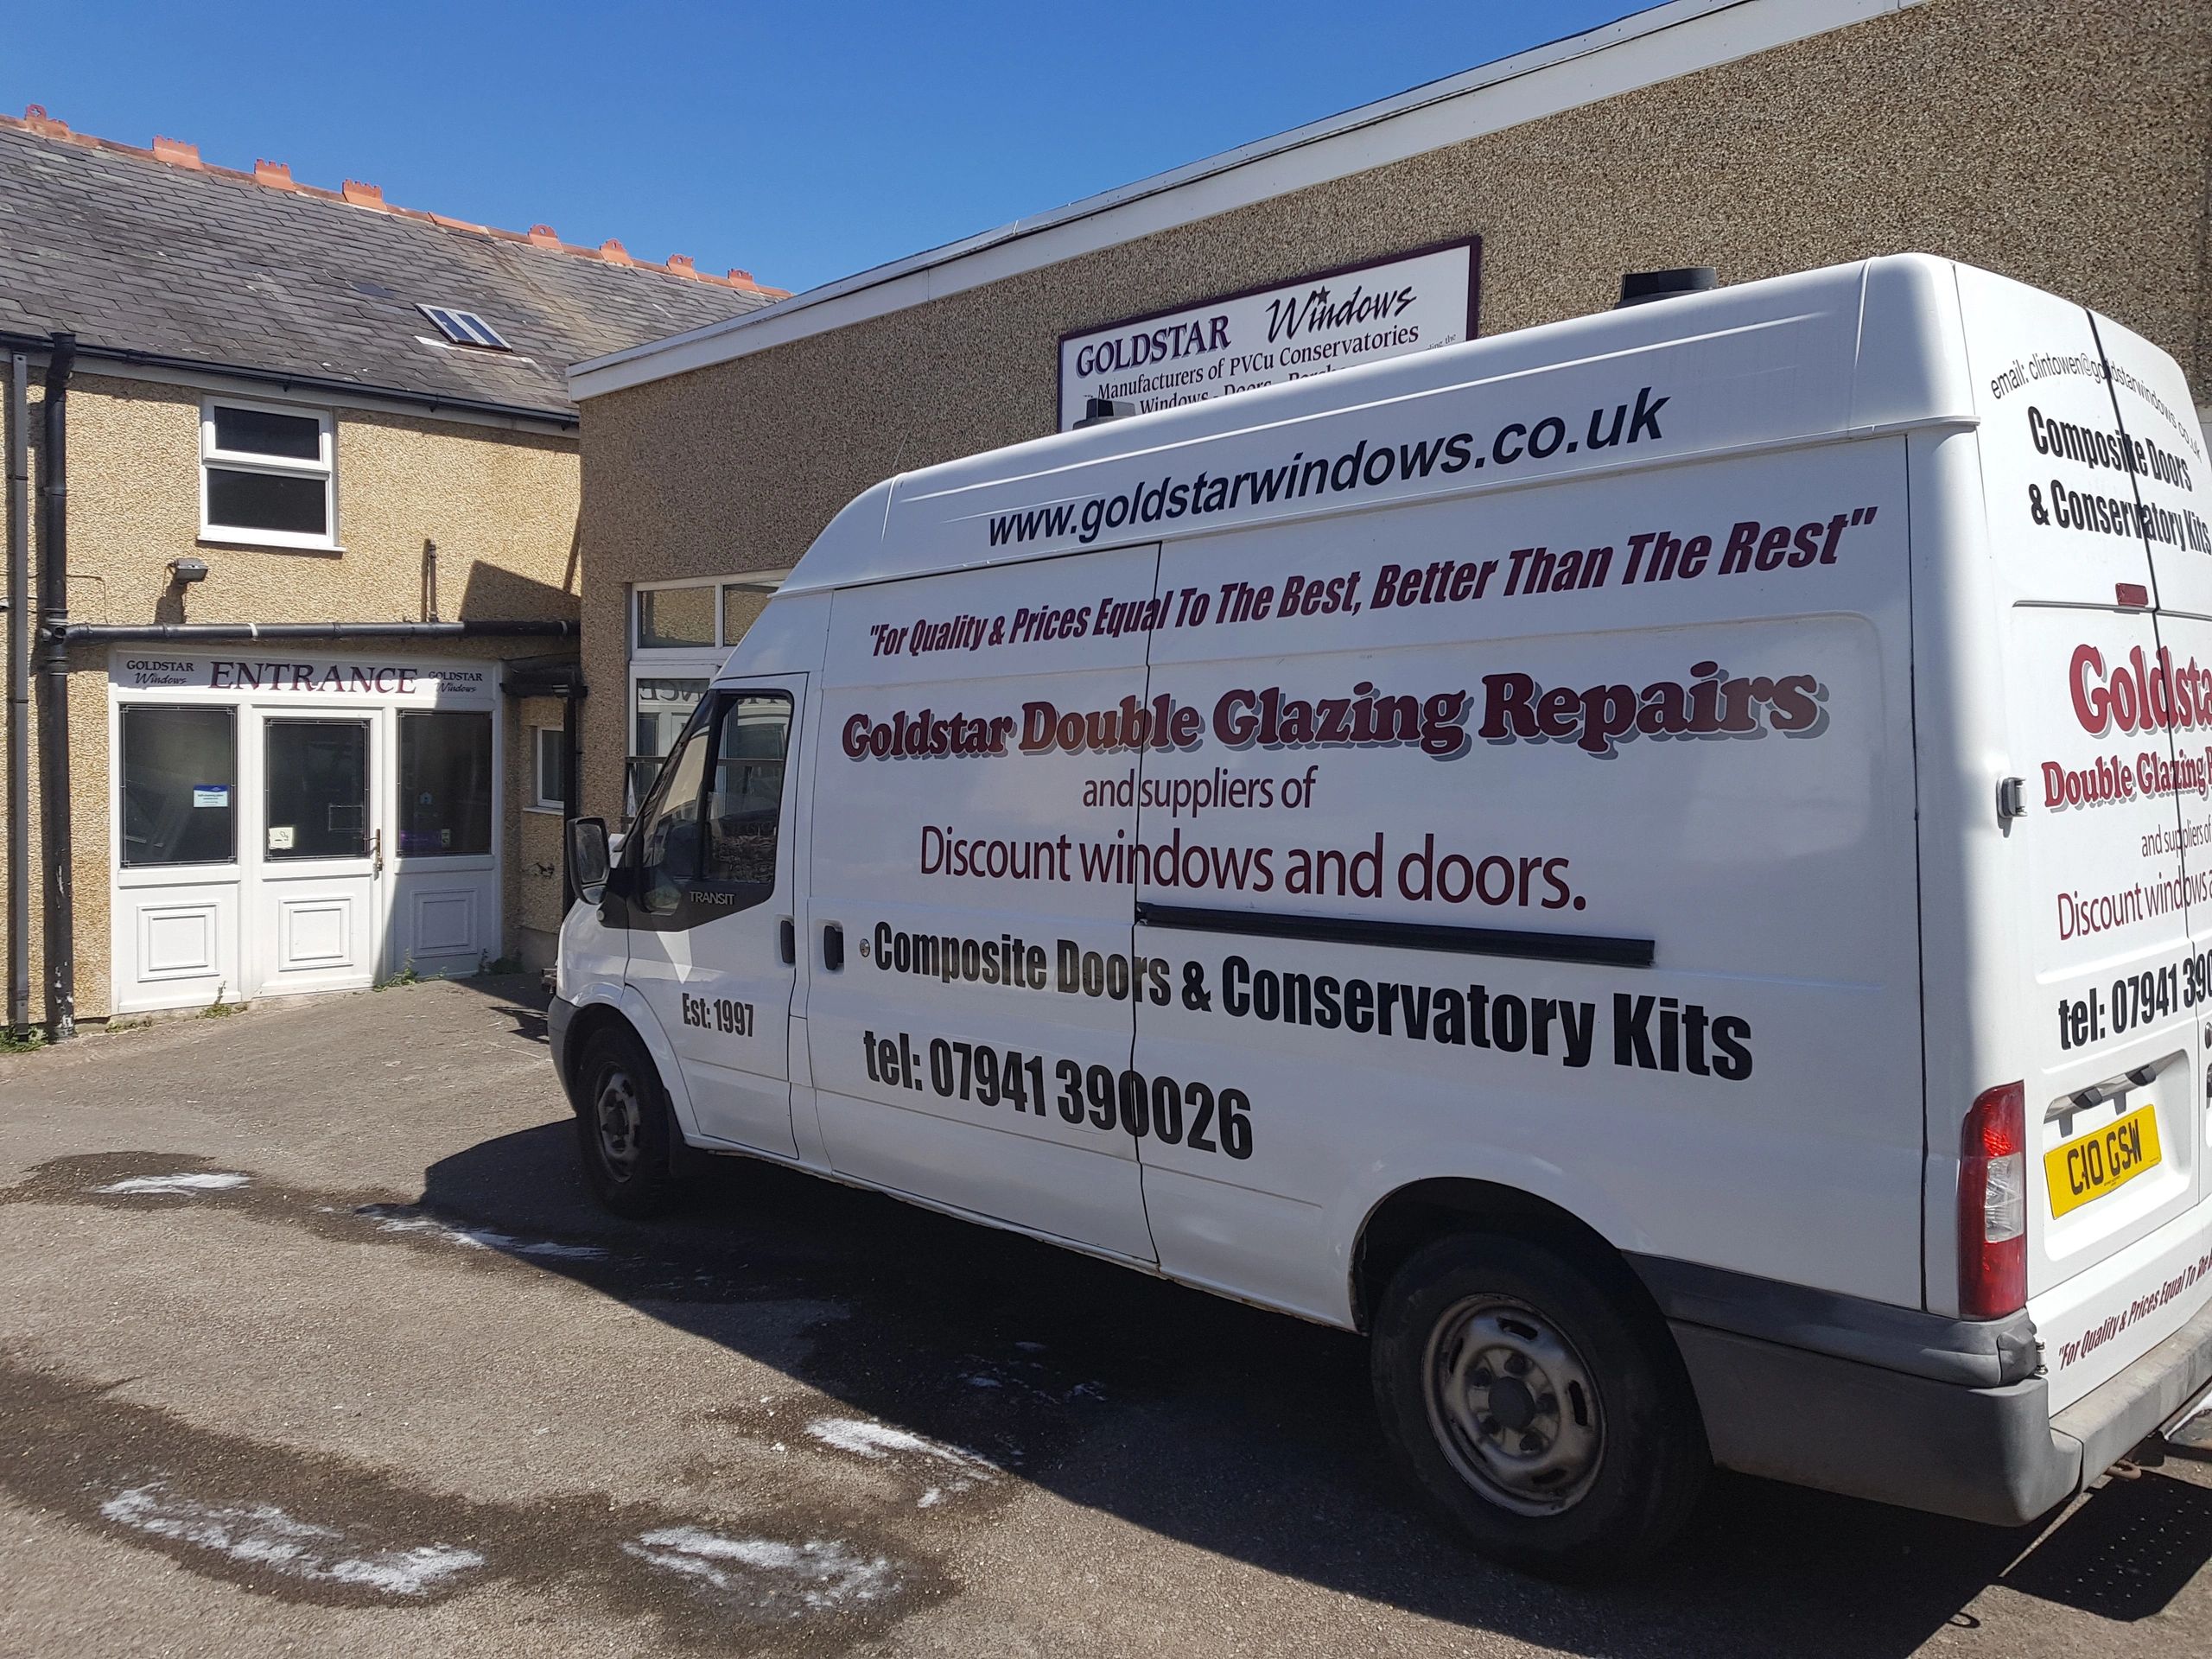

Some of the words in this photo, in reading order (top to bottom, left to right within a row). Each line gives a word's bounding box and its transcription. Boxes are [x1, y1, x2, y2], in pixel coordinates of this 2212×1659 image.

[1076, 315, 1232, 378] GOLDSTAR
[1265, 285, 1418, 344] Windows
[1098, 368, 1204, 399] Manufacturers
[1208, 358, 1226, 380] of
[1230, 353, 1274, 377] PVCu
[1280, 326, 1419, 366] Conservatories
[1140, 391, 1209, 415] Windows
[1990, 359, 2030, 400] email:
[988, 386, 1671, 547] www.goldstarwindows.co.uk
[2027, 405, 2149, 477] Composite
[2145, 437, 2193, 493] Doors
[2028, 483, 2050, 526] &
[2050, 479, 2186, 552] Conservatory
[2183, 508, 2212, 556] Kits
[869, 624, 906, 657] "For
[909, 613, 987, 657] Quality
[988, 615, 1006, 645] &
[1008, 604, 1090, 645] Prices
[1092, 590, 1173, 640] Equal
[1175, 588, 1210, 628] To
[1215, 581, 1274, 623] The
[1276, 569, 1363, 619] Best,
[1370, 558, 1498, 609] Better
[1503, 546, 1614, 597] Than
[1621, 531, 1713, 585] The
[1717, 506, 1878, 575] Rest"
[126, 660, 194, 672] GOLDSTAR
[134, 672, 187, 685] Windows
[208, 660, 418, 694] ENTRANCE
[428, 671, 483, 682] GOLDSTAR
[842, 707, 1016, 760] Goldstar
[1018, 692, 1202, 760] Double
[1212, 681, 1472, 761] Glazing
[1478, 660, 1829, 760] Repairs
[1082, 768, 1135, 808] and
[1140, 766, 1274, 818] suppliers
[1281, 765, 1319, 809] of
[2041, 754, 2135, 810] Double
[2136, 748, 2207, 799] Glazing
[920, 824, 1071, 882] Discount
[1079, 827, 1274, 893] windows
[1284, 831, 1384, 899] and
[1397, 832, 1587, 911] doors.
[2141, 823, 2163, 858] and
[2164, 818, 2204, 858] suppliers
[2203, 813, 2212, 844] of
[690, 891, 734, 906] TRANSIT
[2057, 881, 2144, 941] Discount
[2145, 865, 2208, 918] windows
[682, 992, 711, 1029] Est:
[714, 998, 753, 1037] 1997
[874, 921, 1047, 991] Composite
[1056, 938, 1172, 1007] Doors
[1182, 960, 1211, 1012] &
[1222, 955, 1596, 1068] Conservatory
[1612, 992, 1753, 1081] Kits
[2058, 988, 2106, 1051] tel:
[2112, 963, 2178, 1034] 07941
[863, 1030, 923, 1091] tel:
[930, 1038, 1046, 1117] 07941
[1055, 1059, 1253, 1160] 390026
[2067, 1139, 2104, 1196] C10
[2107, 1118, 2142, 1177] GSW
[2058, 1339, 2082, 1371] "For
[2080, 1314, 2120, 1359] Quality
[2119, 1310, 2127, 1333] &
[2127, 1289, 2160, 1327] Prices
[2158, 1268, 2187, 1305] Equal
[2185, 1264, 2196, 1290] To
